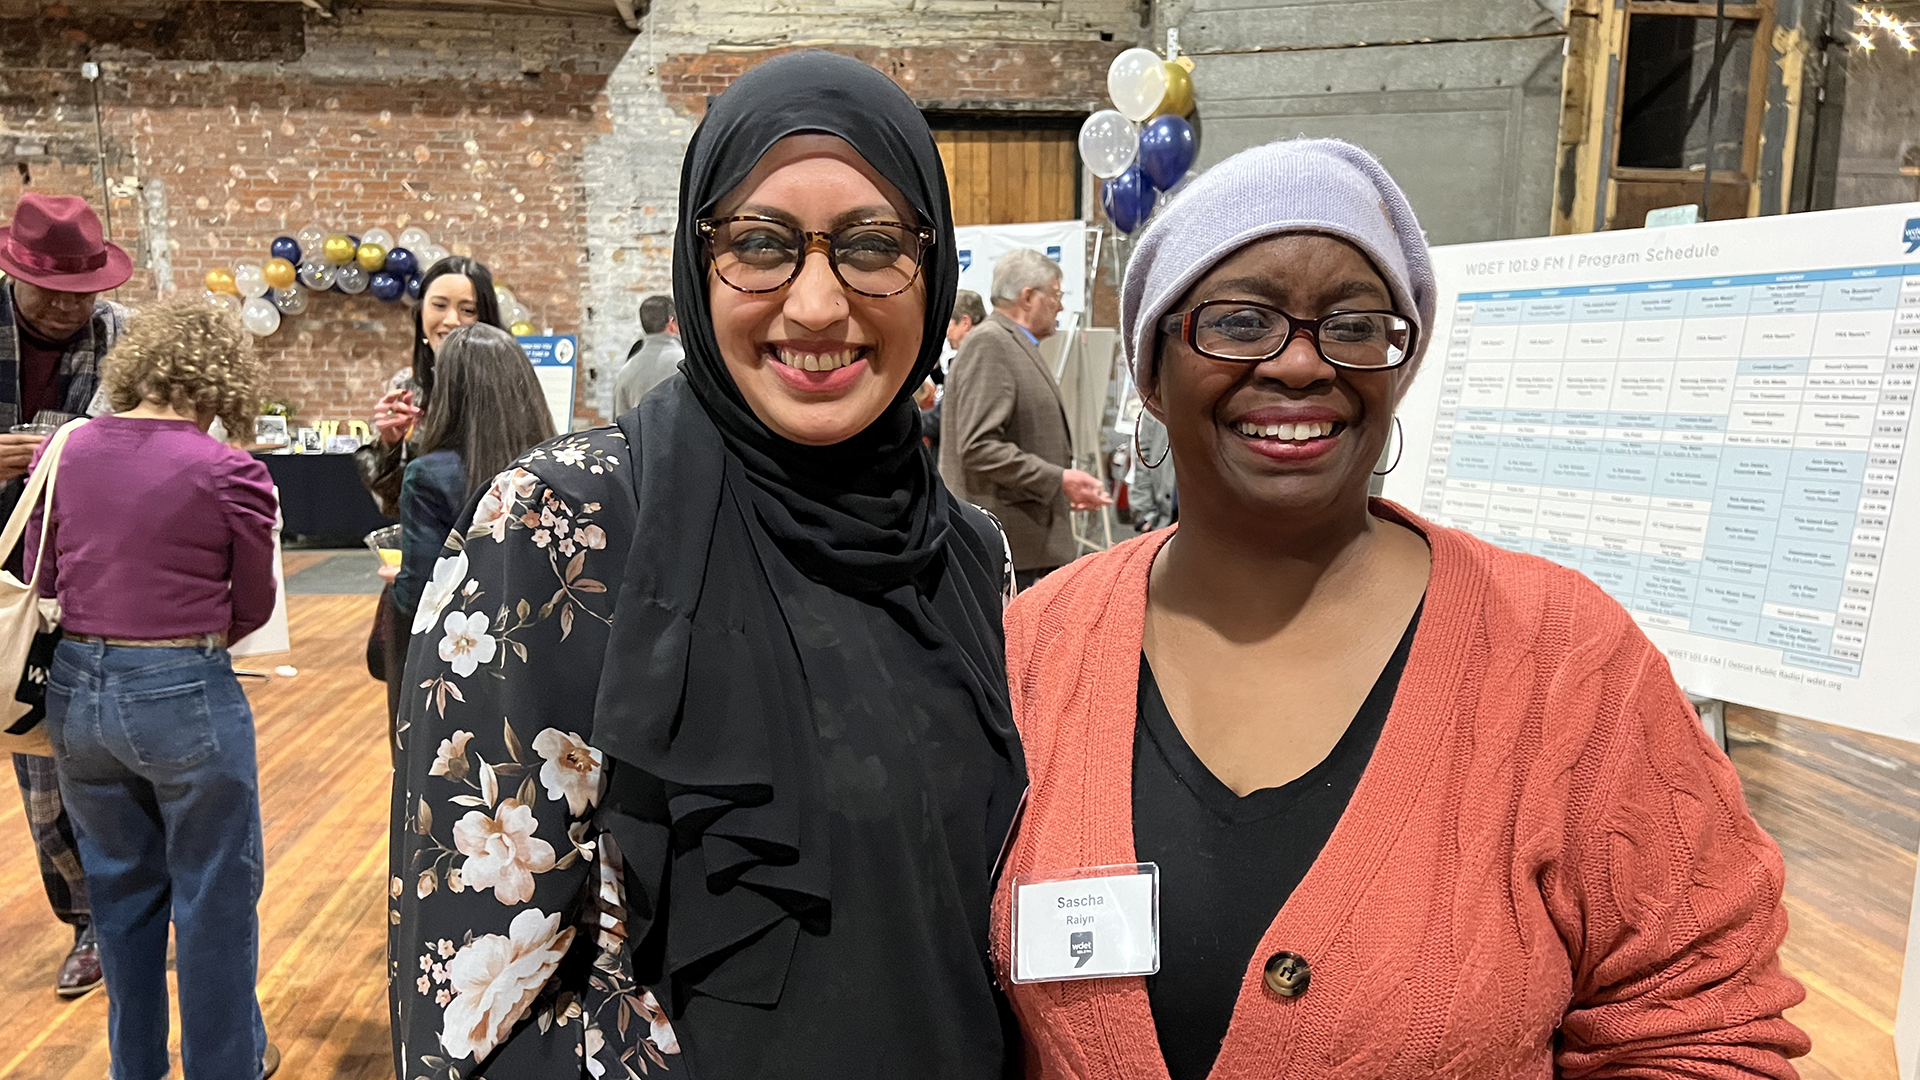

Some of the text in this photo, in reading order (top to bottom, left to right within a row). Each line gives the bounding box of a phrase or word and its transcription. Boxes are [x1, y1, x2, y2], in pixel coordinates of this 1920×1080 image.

[1466, 261, 1504, 276] WDET
[1508, 258, 1538, 273] 101.9
[1544, 256, 1563, 270] FM
[1578, 251, 1640, 268] Program
[1645, 243, 1719, 262] Schedule
[1667, 649, 1688, 659] WDET
[1710, 656, 1721, 666] FM
[1728, 661, 1753, 673] Detroit
[1755, 665, 1777, 678] Public
[1057, 894, 1104, 909] Sascha
[1066, 914, 1095, 926] Raiyn
[1071, 941, 1092, 951] wdet
